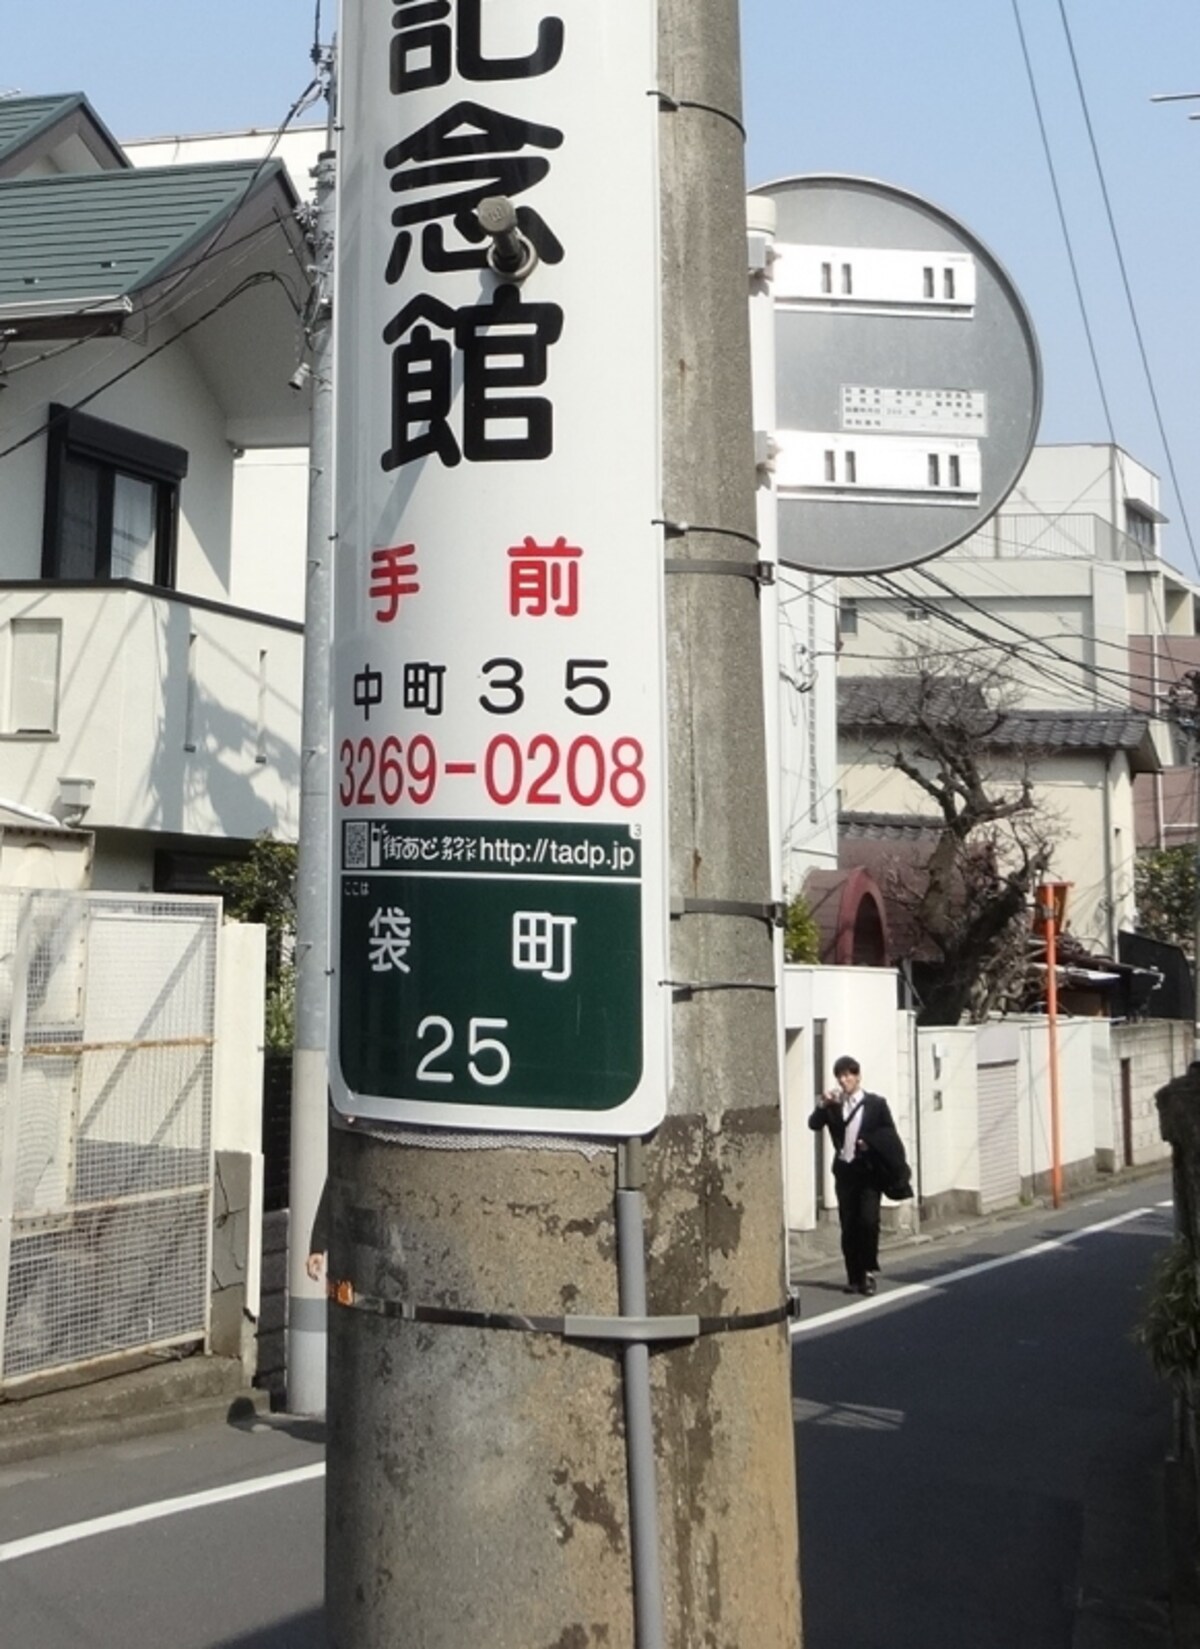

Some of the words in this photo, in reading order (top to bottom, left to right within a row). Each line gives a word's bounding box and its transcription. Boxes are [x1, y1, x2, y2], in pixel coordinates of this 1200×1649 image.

[369, 536, 583, 622] 手前
[339, 733, 646, 808] 3269-0208
[479, 836, 636, 871] http://tadp.jp
[368, 907, 577, 981] 袋町
[416, 1015, 511, 1086] 25
